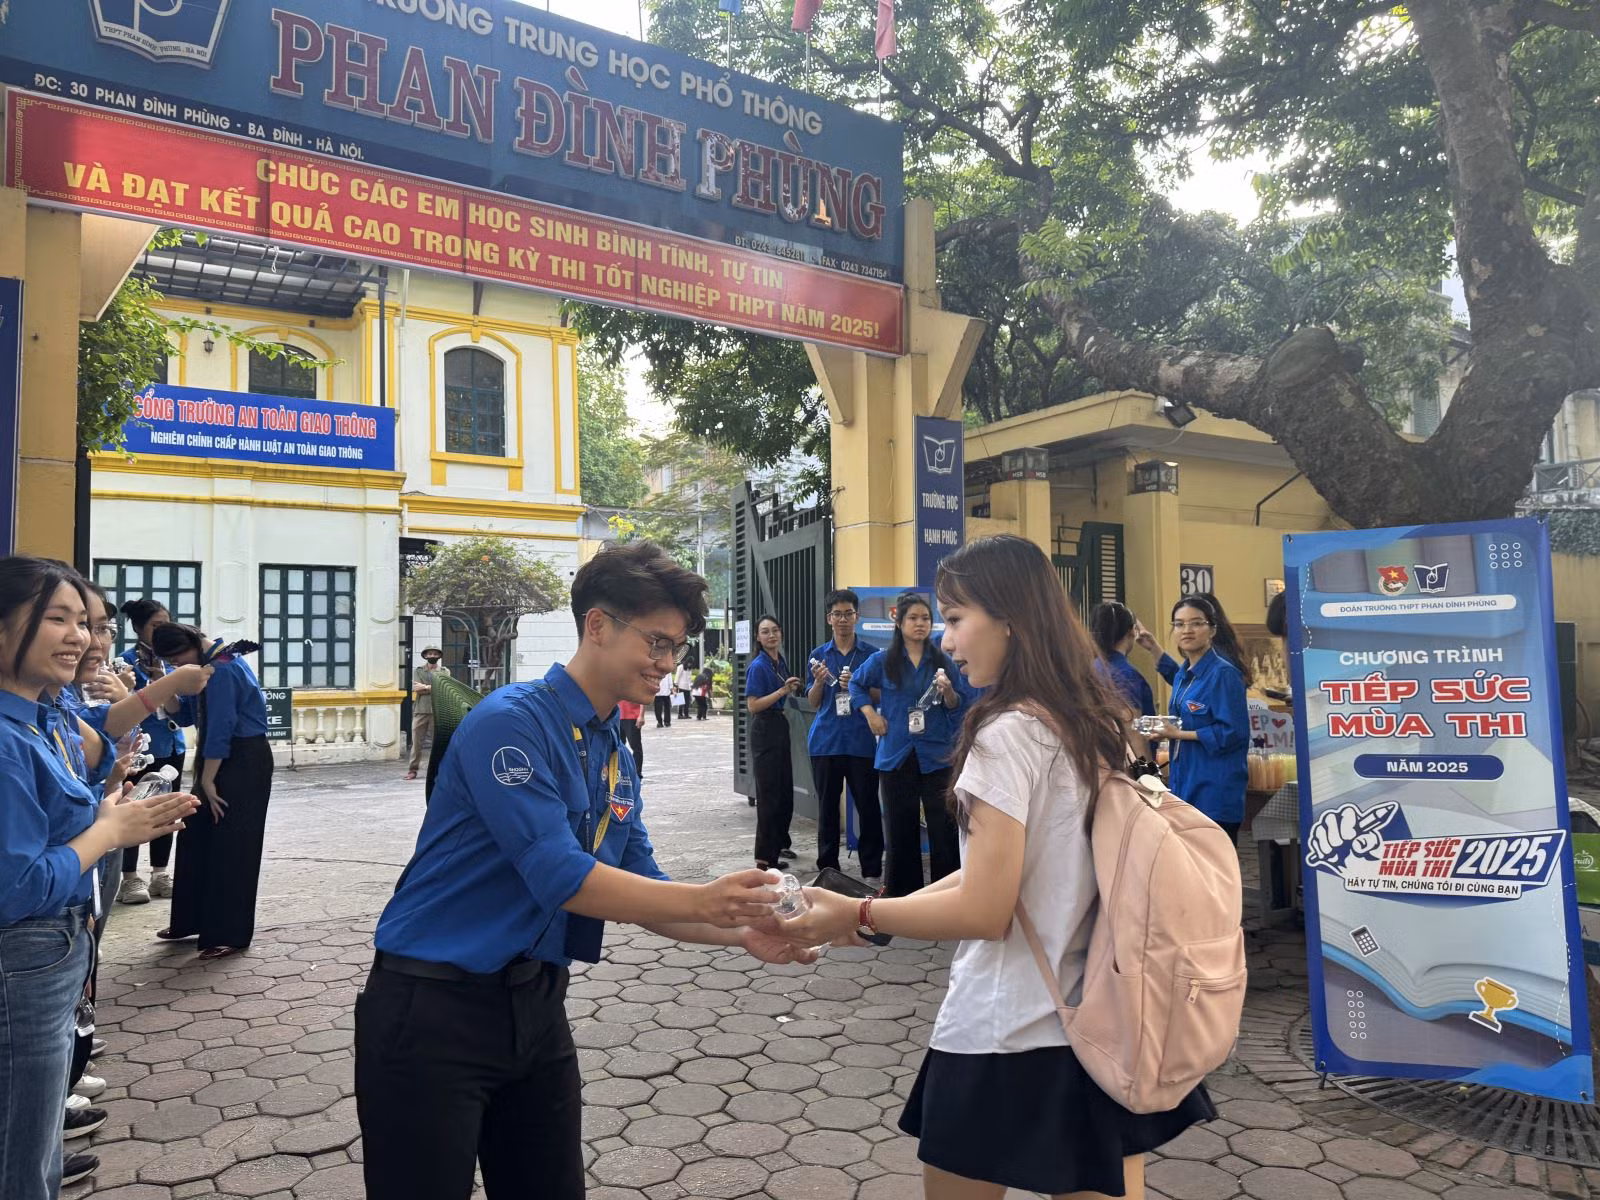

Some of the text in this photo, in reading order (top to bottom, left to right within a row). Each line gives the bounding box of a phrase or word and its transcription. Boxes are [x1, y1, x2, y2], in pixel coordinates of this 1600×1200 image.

[504, 15, 599, 68] TRUNG
[609, 48, 671, 89] HỌC
[680, 71, 733, 109] PHỔ
[742, 89, 823, 135] THÔNG
[34, 73, 62, 91] ĐC:
[70, 82, 88, 97] 30
[96, 88, 136, 108] PHAN
[143, 97, 177, 118] ĐÌNH
[184, 105, 231, 130] PHÙNG
[248, 122, 266, 139] BA
[273, 126, 303, 147] ĐÌNH
[316, 136, 334, 153] HÀ
[340, 142, 365, 162] NỘI.
[270, 8, 886, 240] PHAN ĐÌNH PHÙNG
[257, 158, 783, 289] CHÚC CÁC EM HỌC SINH BÌNH TĨNH, TỰ TIN
[64, 162, 880, 340] VÀ ĐẠT KẾT QUẢ CAO TRONG KỲ THI TỐT NGHIỆP THPT NĂM 2025!
[735, 235, 748, 248] ĐT:
[752, 240, 771, 252] 0243
[841, 259, 858, 272] 0243
[133, 388, 377, 439] CỔNG TRƯỜNG AN TOÀN GIAO THÔNG
[150, 431, 364, 460] NGHIÊM CHỈNH CHẤP HÀNH LUẬT AN TOÀN GIAO THÔNG
[922, 490, 945, 509] TRƯỜNG
[946, 495, 959, 513] HỌC
[924, 528, 958, 547] HẠNH PHÚC
[1182, 569, 1211, 595] 30
[1400, 603, 1419, 611] THPT
[1422, 602, 1444, 610] PHAN
[1446, 600, 1466, 609] ĐÌNH
[1468, 599, 1497, 607] PHÙNG
[1340, 646, 1503, 666] CHƯƠNG TRÌNH
[1321, 670, 1530, 704] TIẾP SỨC
[1328, 709, 1527, 738] MÙA THI
[1387, 759, 1468, 773] NĂM 2025
[1383, 837, 1462, 859] TIẾP SỨC
[1456, 836, 1552, 877] 2025
[1379, 858, 1453, 878] MÙA THI
[1348, 877, 1518, 896] HÃY TỰ TIN, CHÚNG TÔI ĐI CÙNG BẠN
